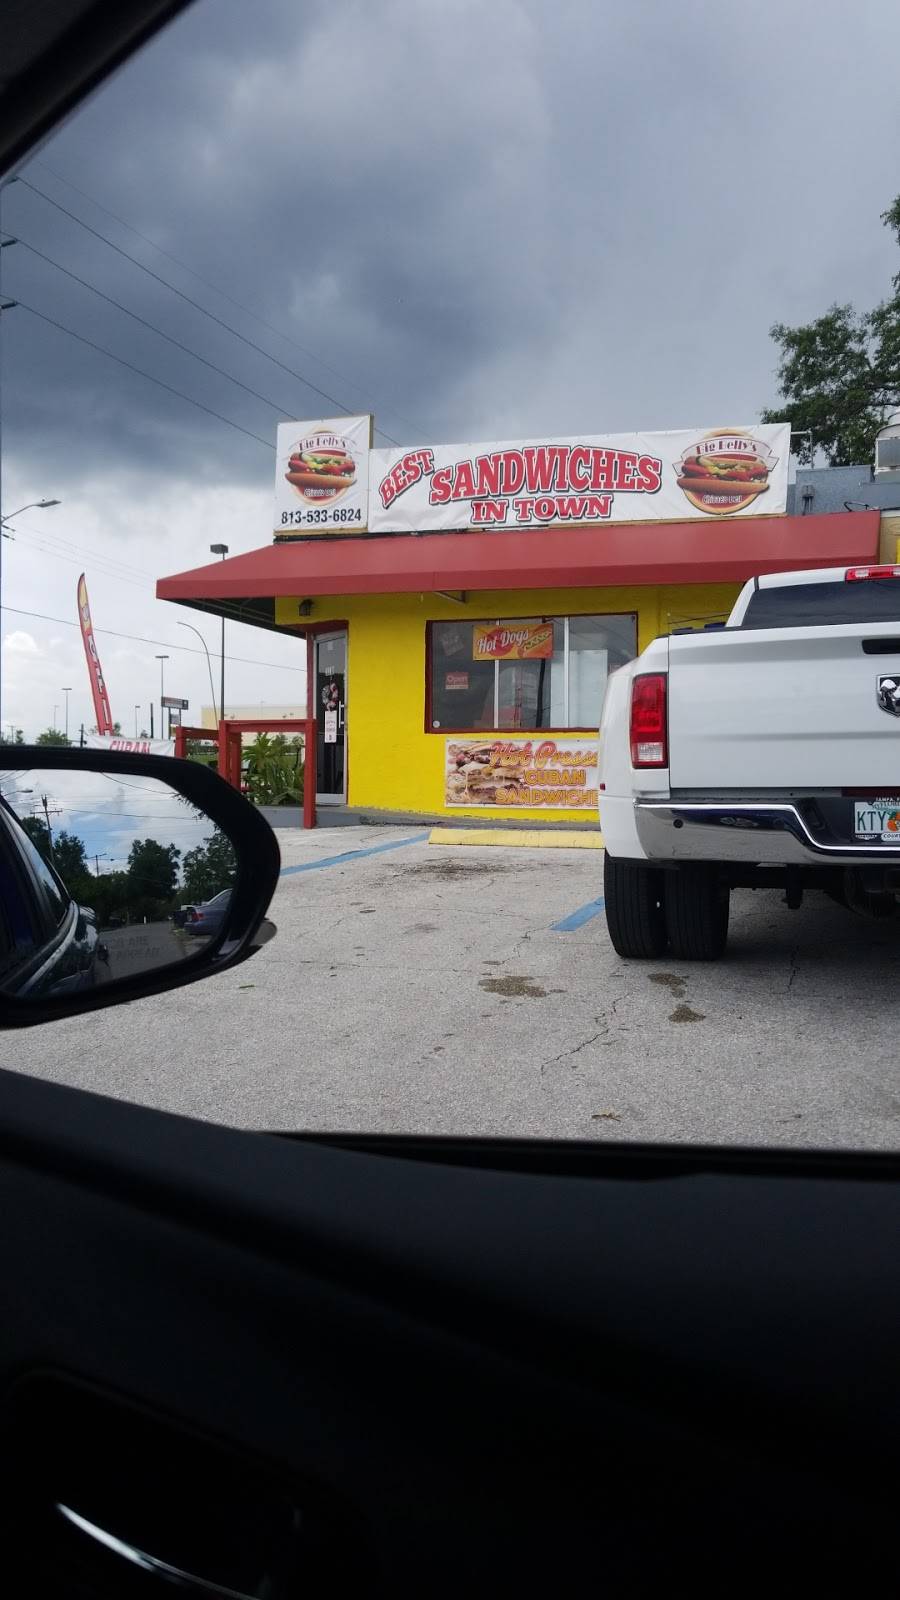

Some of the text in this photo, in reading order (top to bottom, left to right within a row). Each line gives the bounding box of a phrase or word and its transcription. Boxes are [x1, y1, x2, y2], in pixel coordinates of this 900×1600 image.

[378, 449, 435, 509] BEST
[429, 445, 662, 505] SANDWICHES
[281, 508, 362, 524] 813-533-6824
[472, 495, 614, 523] IN TOWN
[477, 635, 499, 654] Hot
[500, 629, 529, 648] Dogs
[446, 675, 468, 685] Open
[490, 741, 533, 768] Hot
[524, 769, 587, 786] CUBAN
[857, 811, 886, 831] KTY
